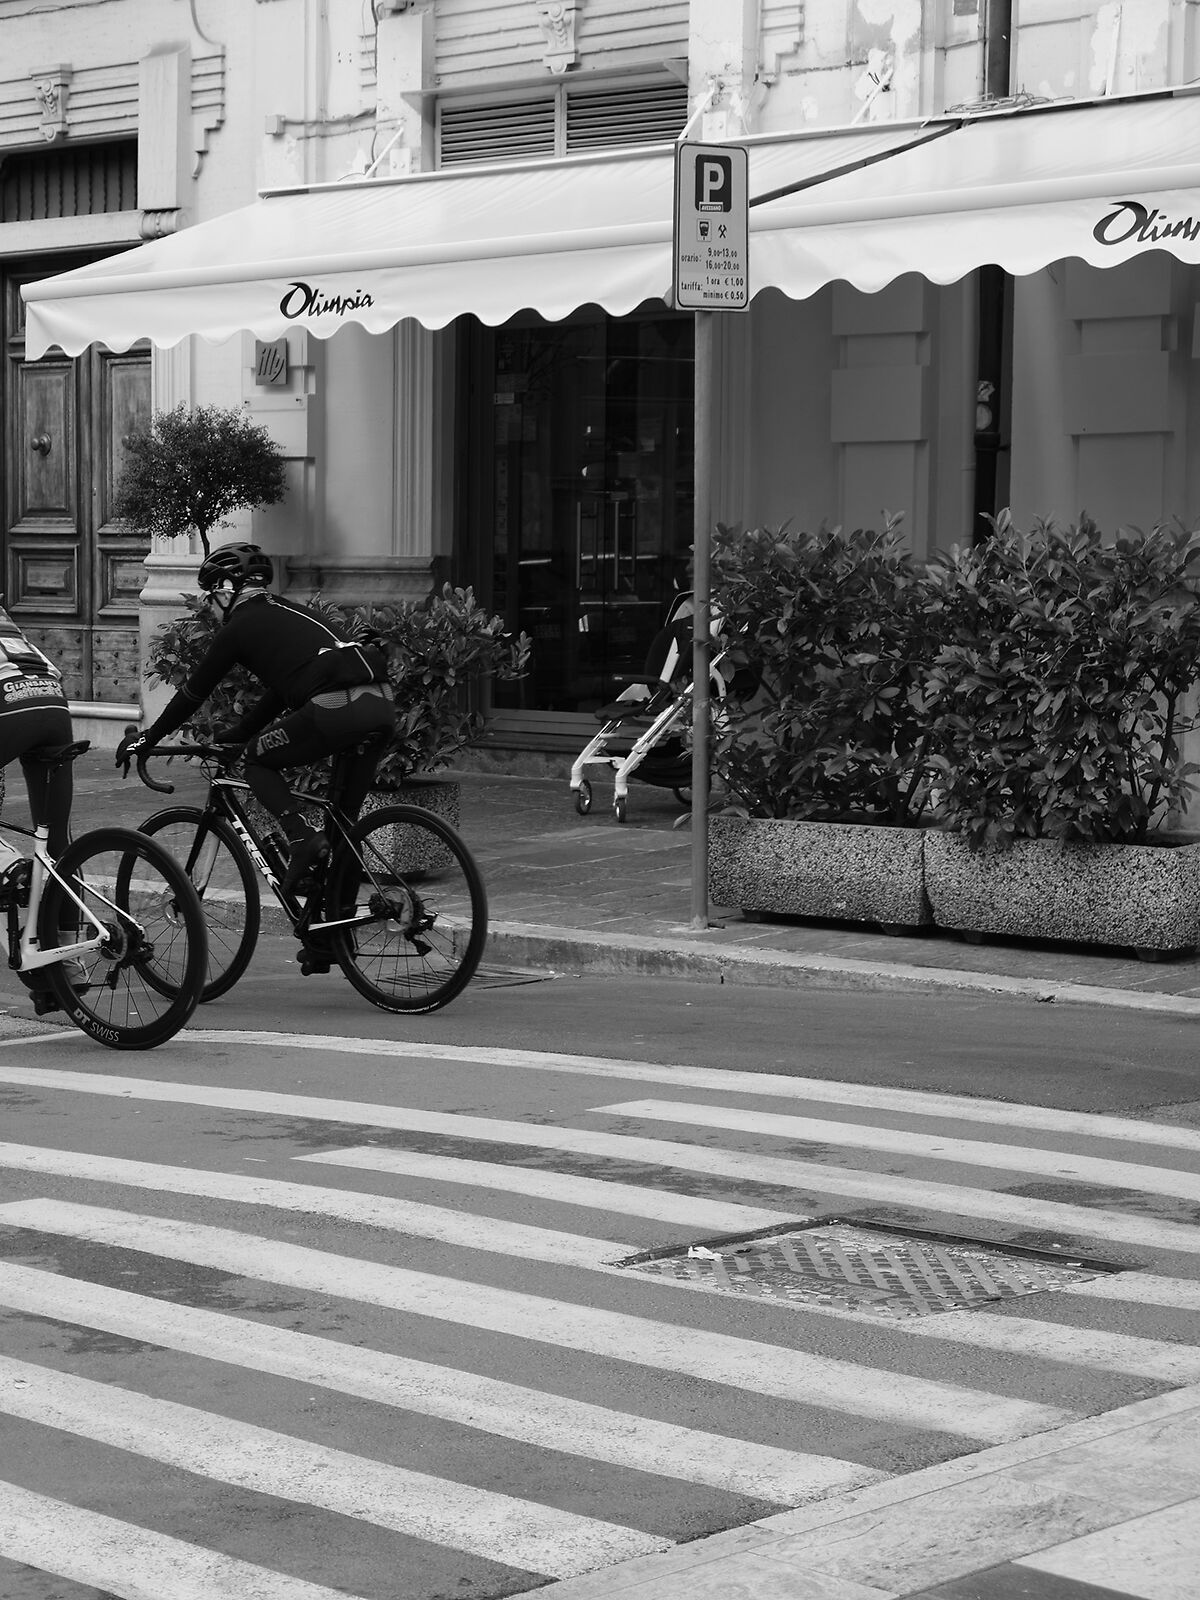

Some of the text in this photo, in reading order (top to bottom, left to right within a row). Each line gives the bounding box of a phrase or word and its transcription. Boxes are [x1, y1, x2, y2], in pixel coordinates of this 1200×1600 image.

[703, 162, 725, 203] P
[681, 253, 702, 262] orario:
[280, 282, 375, 319] Olimpia
[681, 281, 703, 291] tariffa:
[703, 289, 723, 299] minimo
[258, 347, 285, 382] illy
[232, 815, 280, 887] TREK
[74, 1008, 120, 1041] DT SWISS
